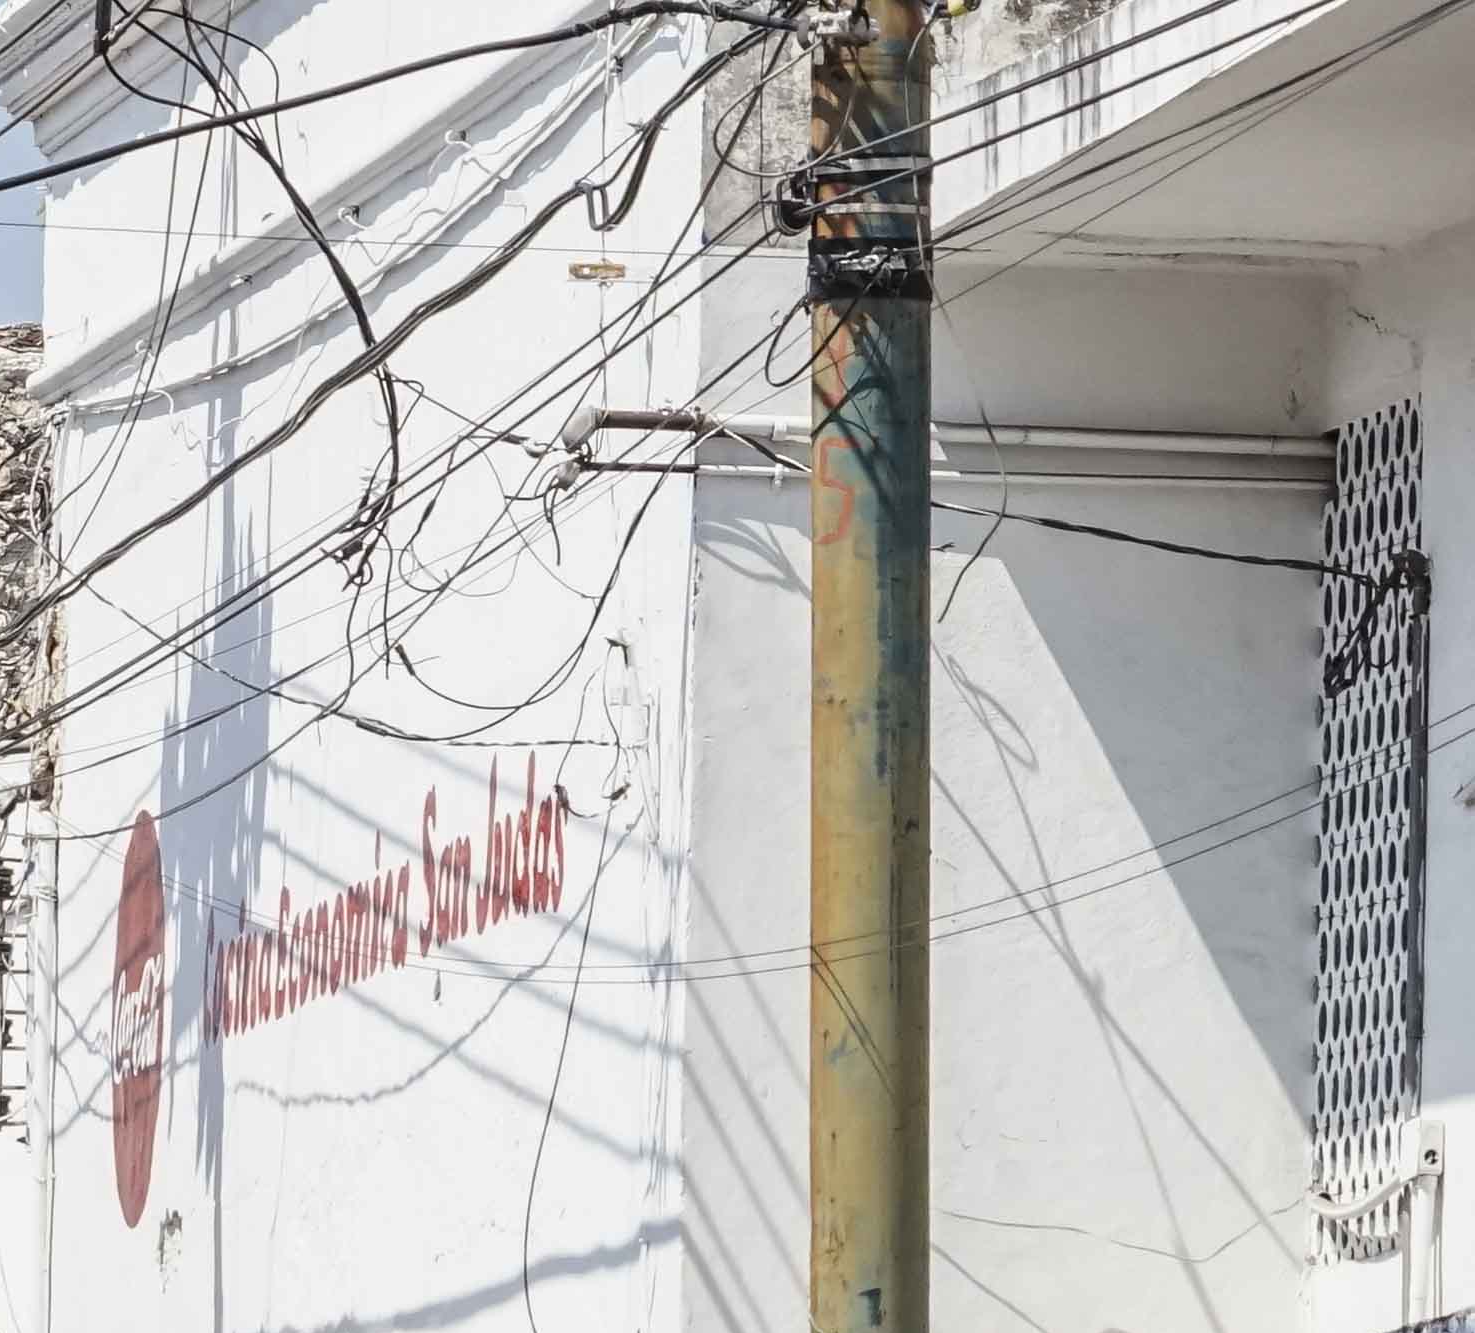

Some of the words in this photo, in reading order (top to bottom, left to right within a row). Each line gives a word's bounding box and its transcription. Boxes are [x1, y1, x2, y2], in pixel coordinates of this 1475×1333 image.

[203, 897, 274, 1048] Cocina
[418, 783, 472, 958] San
[475, 748, 569, 936] Judas
